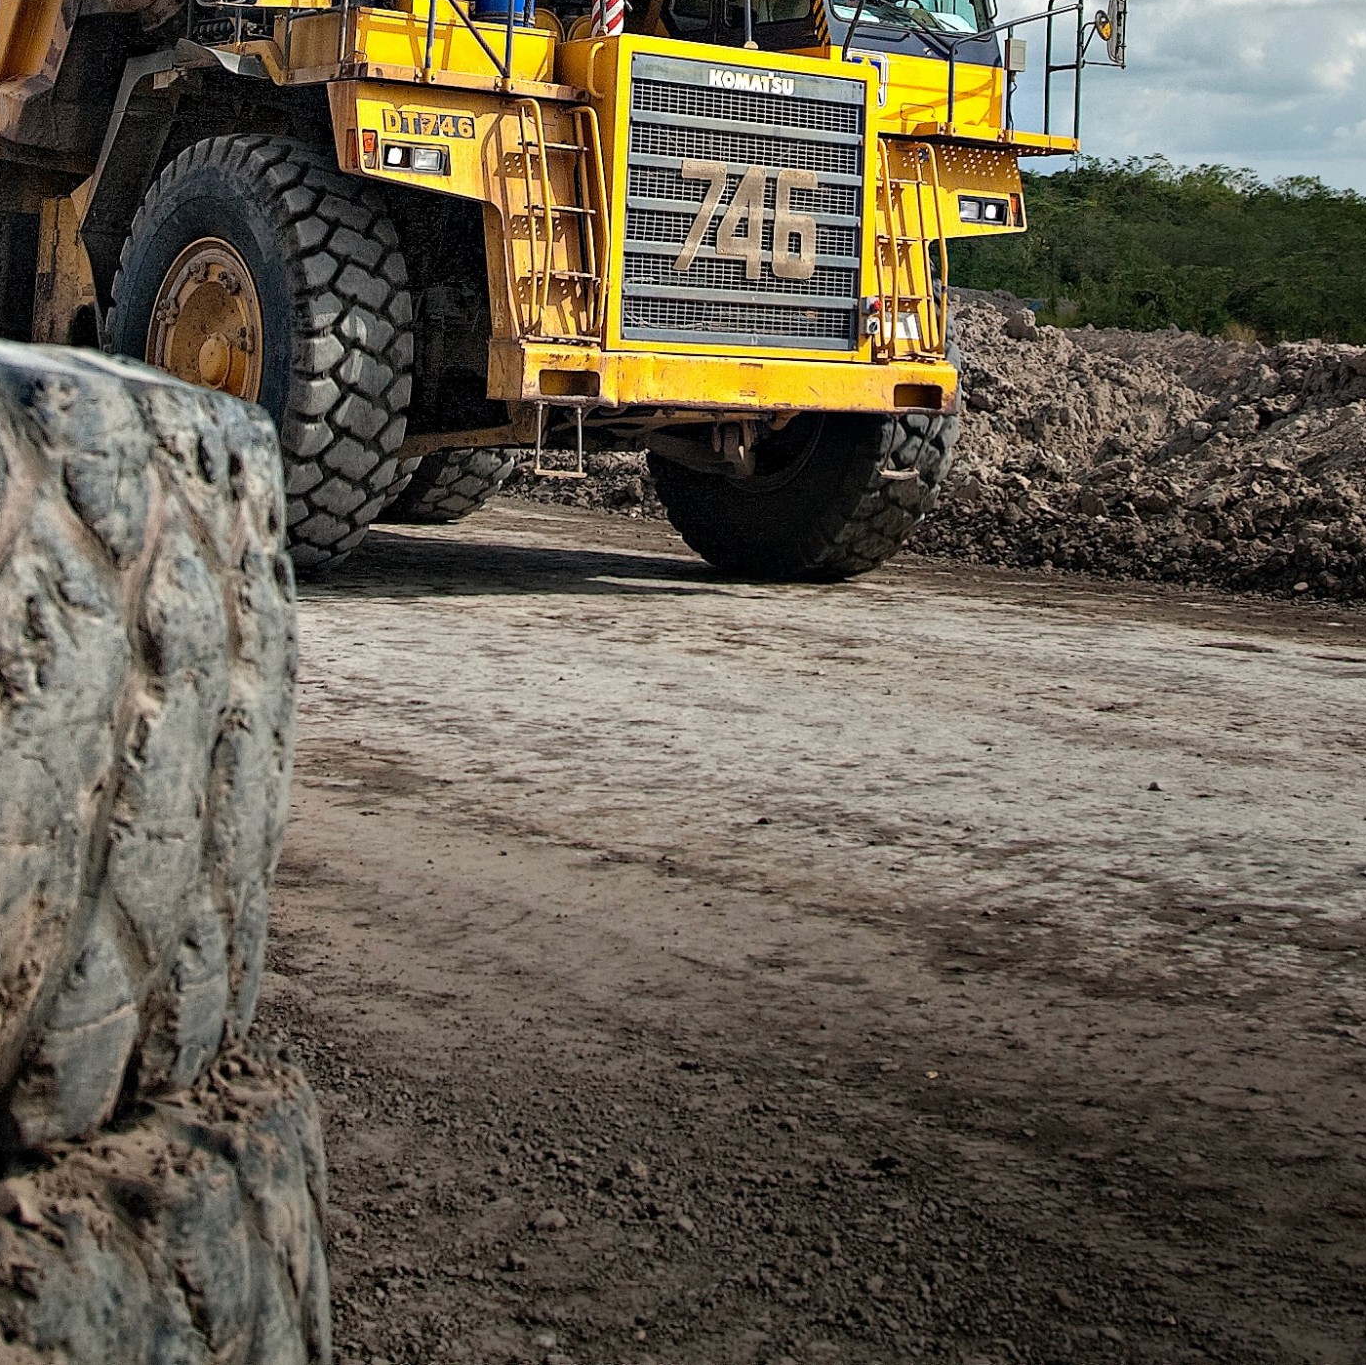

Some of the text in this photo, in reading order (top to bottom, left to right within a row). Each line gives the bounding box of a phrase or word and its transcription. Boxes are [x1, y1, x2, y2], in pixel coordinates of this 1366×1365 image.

[709, 68, 794, 95] KOMATSU
[382, 109, 475, 139] DT746
[672, 158, 818, 279] 746
